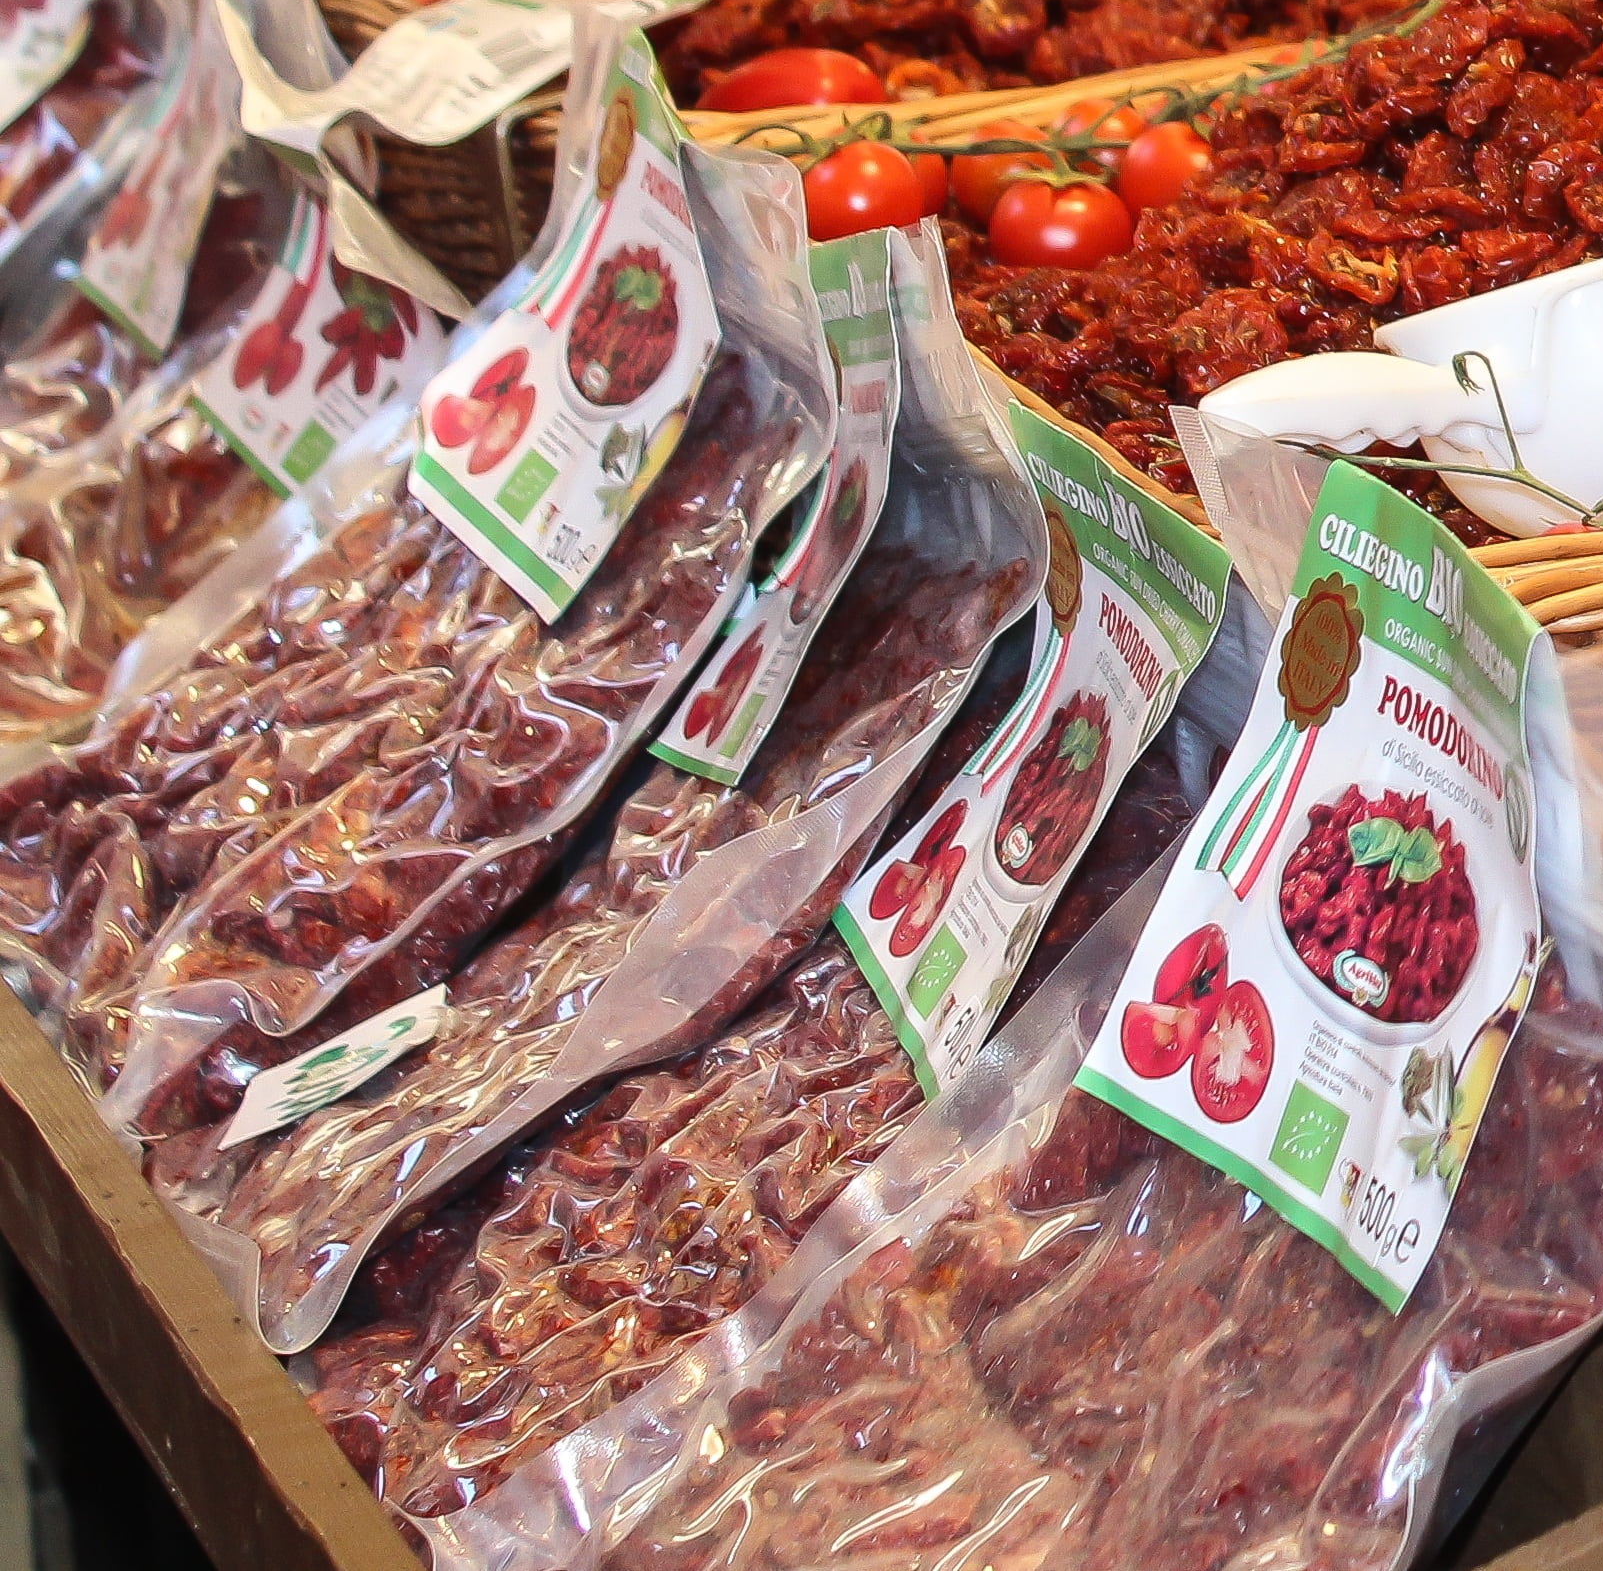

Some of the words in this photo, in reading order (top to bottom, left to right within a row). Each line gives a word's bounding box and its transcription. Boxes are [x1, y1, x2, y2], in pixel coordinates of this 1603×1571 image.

[1028, 451, 1110, 528] CILIEGINO
[1103, 479, 1152, 561] BIO
[1318, 512, 1425, 603] CILIEGINO
[1098, 591, 1164, 703] POMODORINO
[1377, 674, 1505, 803] POMODORINO
